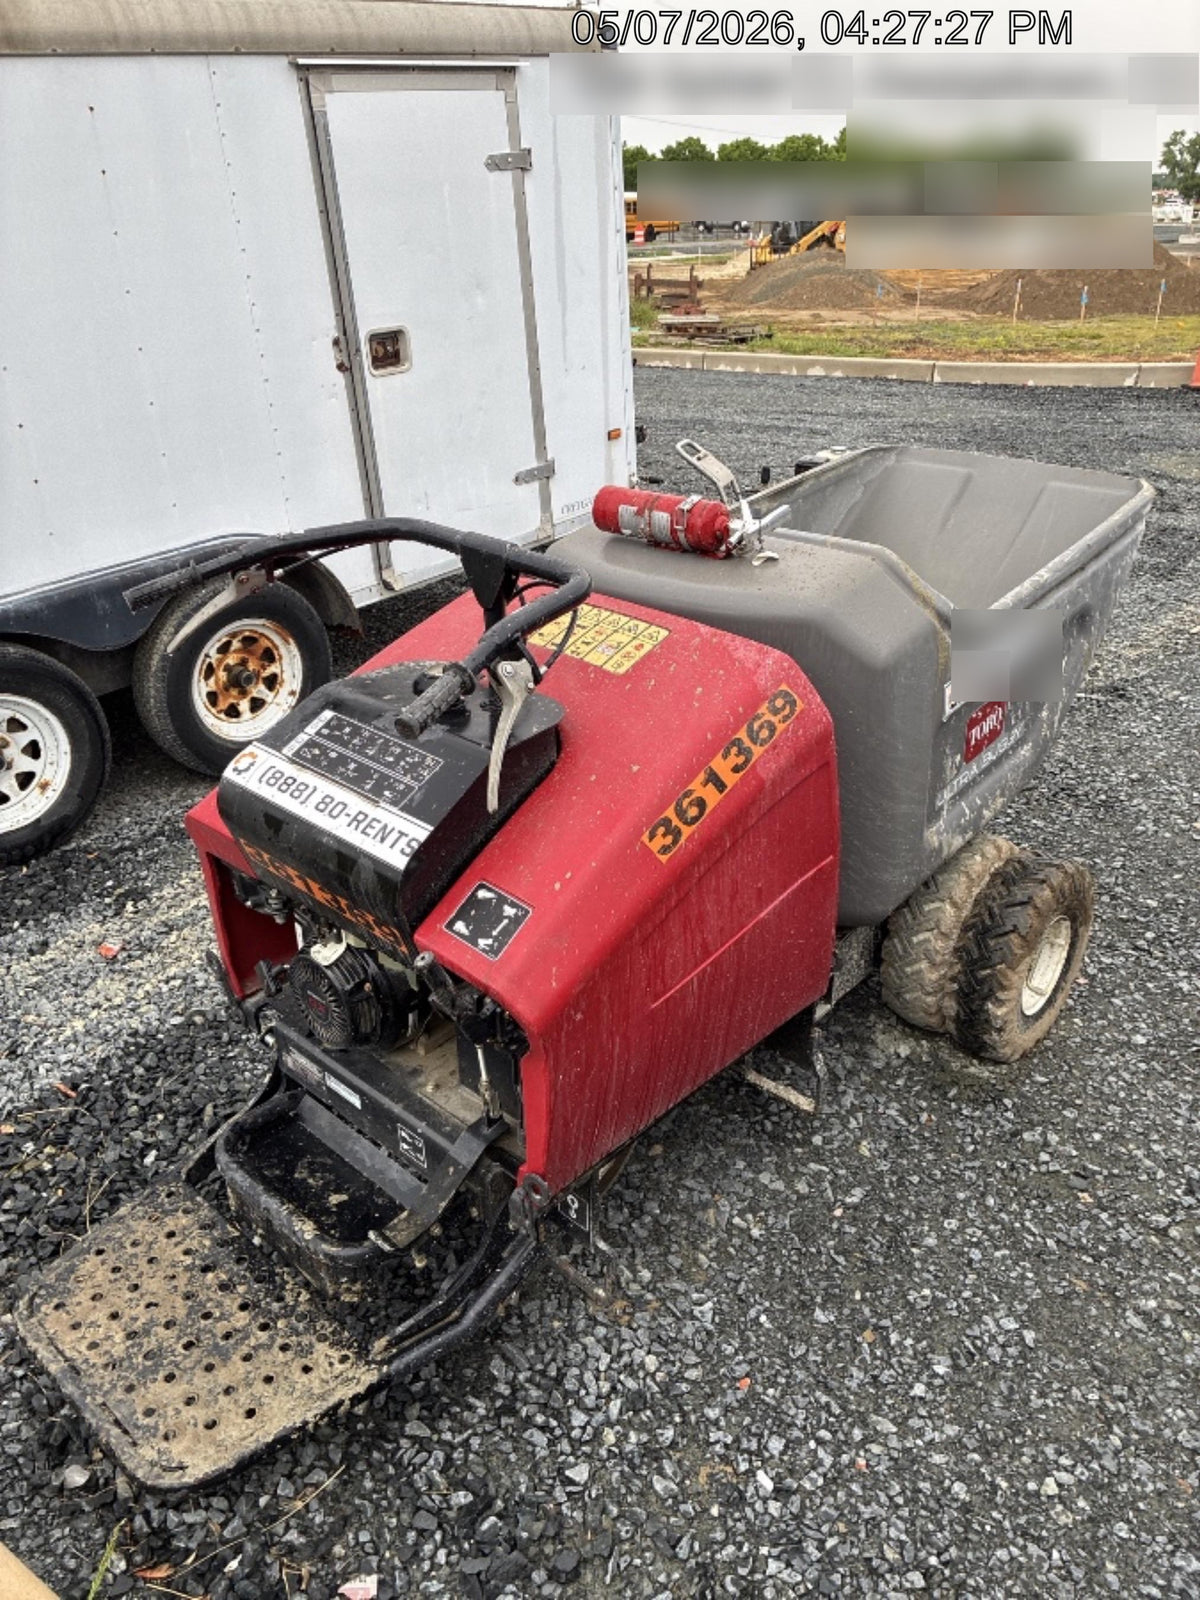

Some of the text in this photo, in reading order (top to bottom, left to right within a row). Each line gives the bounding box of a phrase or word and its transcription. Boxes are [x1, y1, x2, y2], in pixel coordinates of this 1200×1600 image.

[968, 705, 1003, 746] TORO
[258, 765, 422, 857] (888) 80-RENTS
[648, 689, 798, 856] 361369
